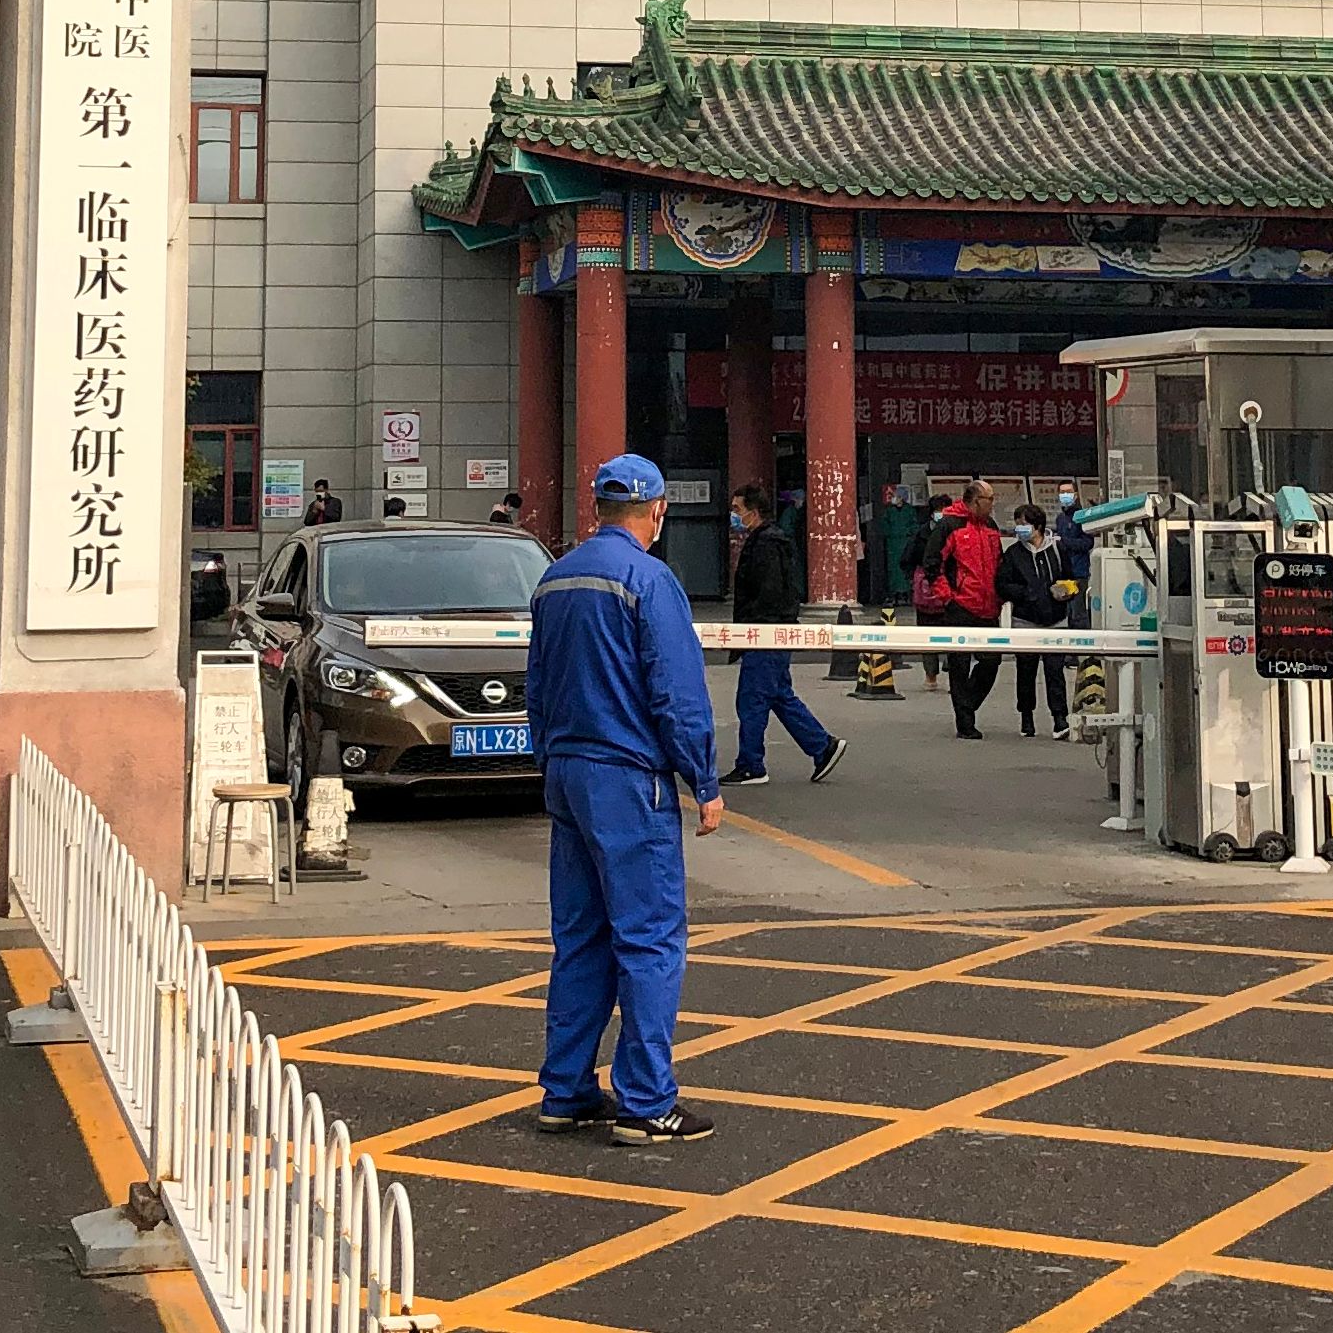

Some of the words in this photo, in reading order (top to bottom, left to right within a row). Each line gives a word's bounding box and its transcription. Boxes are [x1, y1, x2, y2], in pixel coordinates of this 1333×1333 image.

[67, 86, 133, 596] 第一临床医药研究所
[1288, 564, 1327, 577] 好停车
[702, 628, 761, 645] 一车一杆
[773, 627, 833, 646] 闯杆自负
[214, 705, 241, 719] 禁止
[213, 722, 240, 737] 行人
[209, 739, 246, 753] 三轮车
[454, 726, 534, 751] 京N·LX28
